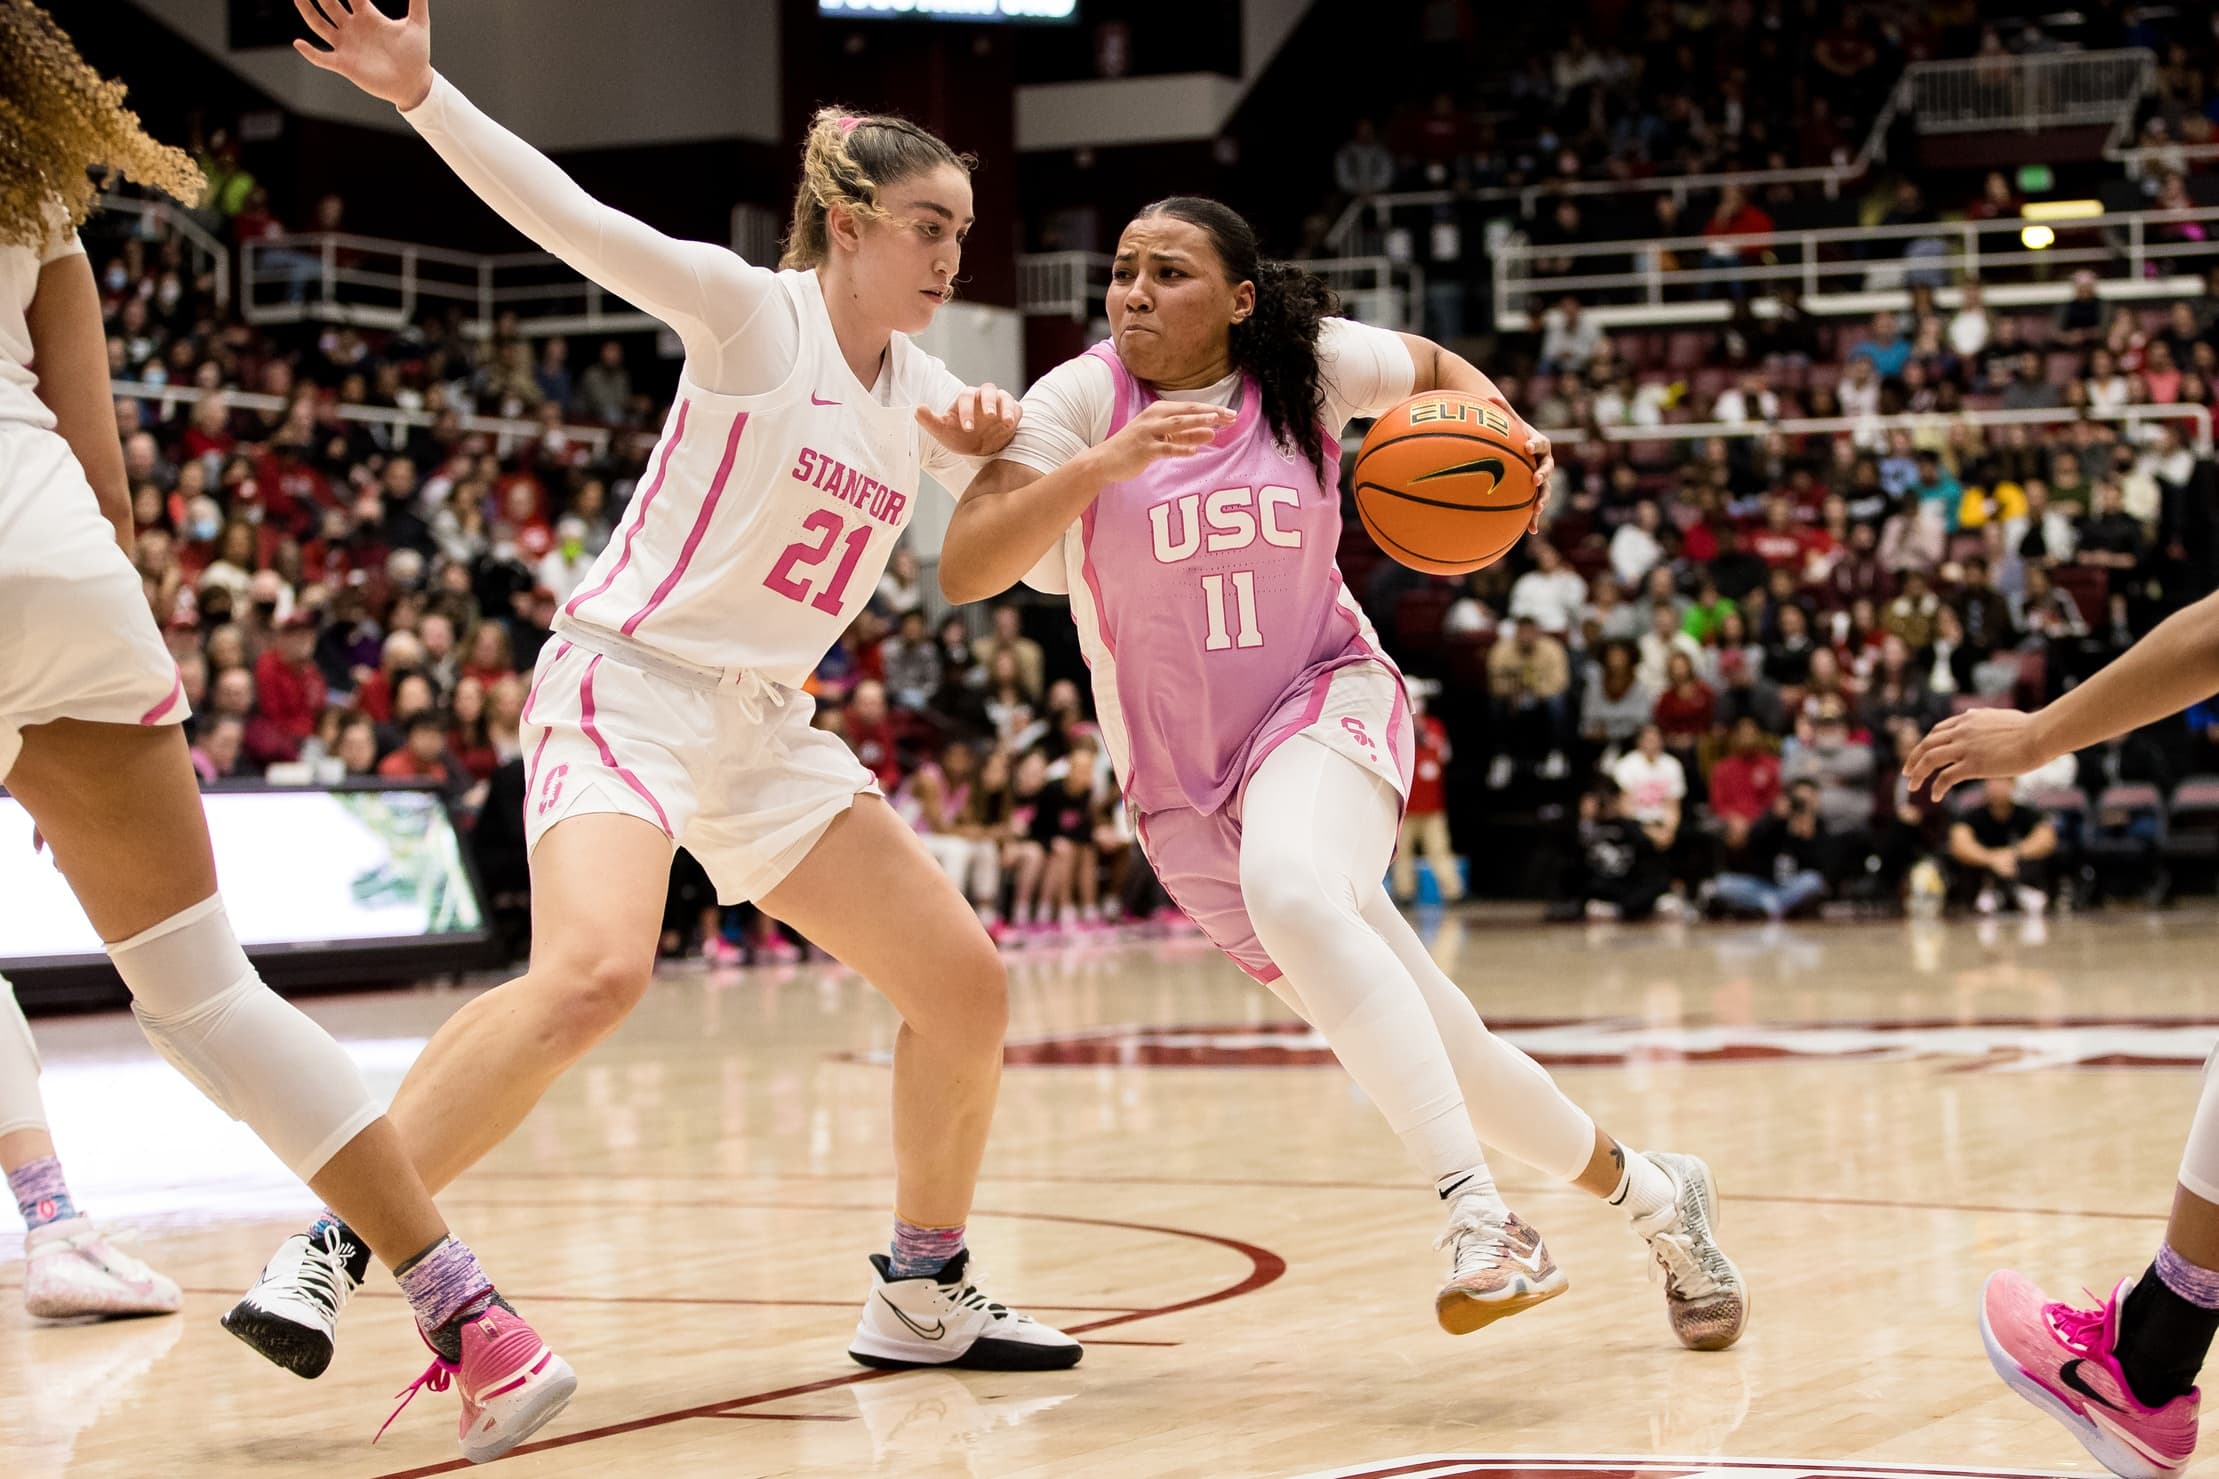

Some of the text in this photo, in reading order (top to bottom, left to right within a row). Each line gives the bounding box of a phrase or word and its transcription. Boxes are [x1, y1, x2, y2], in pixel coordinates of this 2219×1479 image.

[1410, 399, 1510, 440] ELITE
[762, 508, 873, 617] 21
[1147, 484, 1303, 564] USC
[1201, 570, 1264, 652] 11
